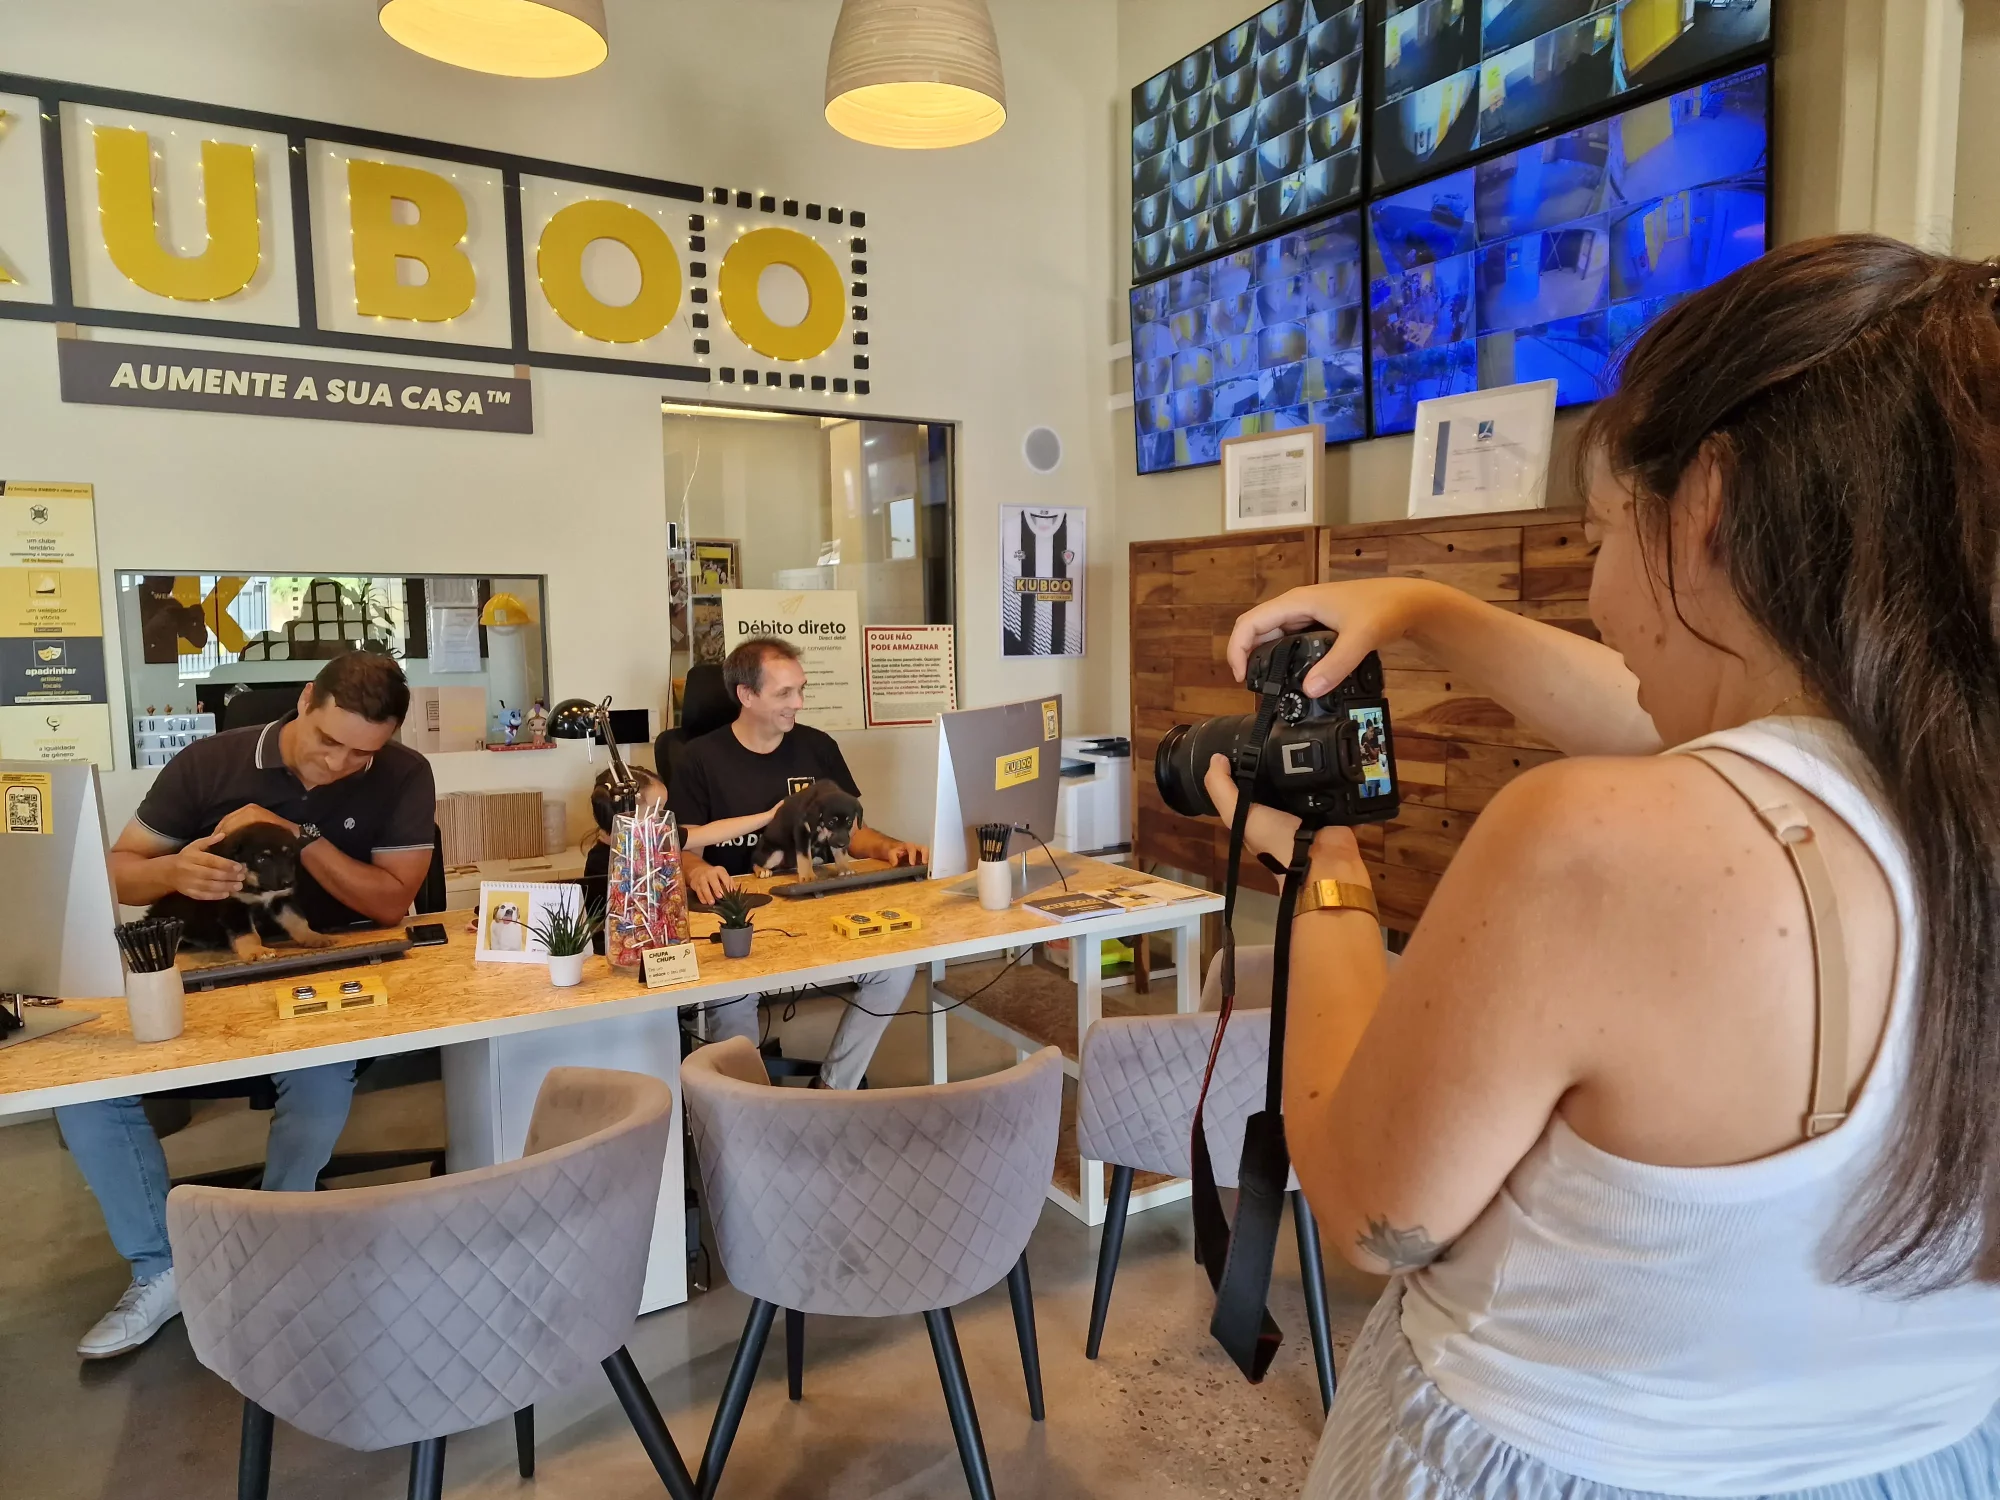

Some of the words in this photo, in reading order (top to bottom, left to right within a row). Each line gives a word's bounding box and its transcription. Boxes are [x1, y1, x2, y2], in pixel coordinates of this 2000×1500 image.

[0, 108, 846, 362] UBOO
[110, 362, 287, 399] AUMENTE
[294, 376, 319, 402] A
[325, 379, 393, 407] SUA
[1016, 579, 1071, 592] KUBOO
[738, 619, 793, 635] Débito
[798, 619, 846, 635] direto
[878, 633, 894, 641] QUE
[895, 632, 912, 640] NÃO
[892, 643, 939, 651] ARMAZENAR
[25, 667, 76, 676] apadrinhar
[138, 720, 155, 732] EU
[168, 720, 196, 731] SOU
[649, 951, 668, 959] CHUPA
